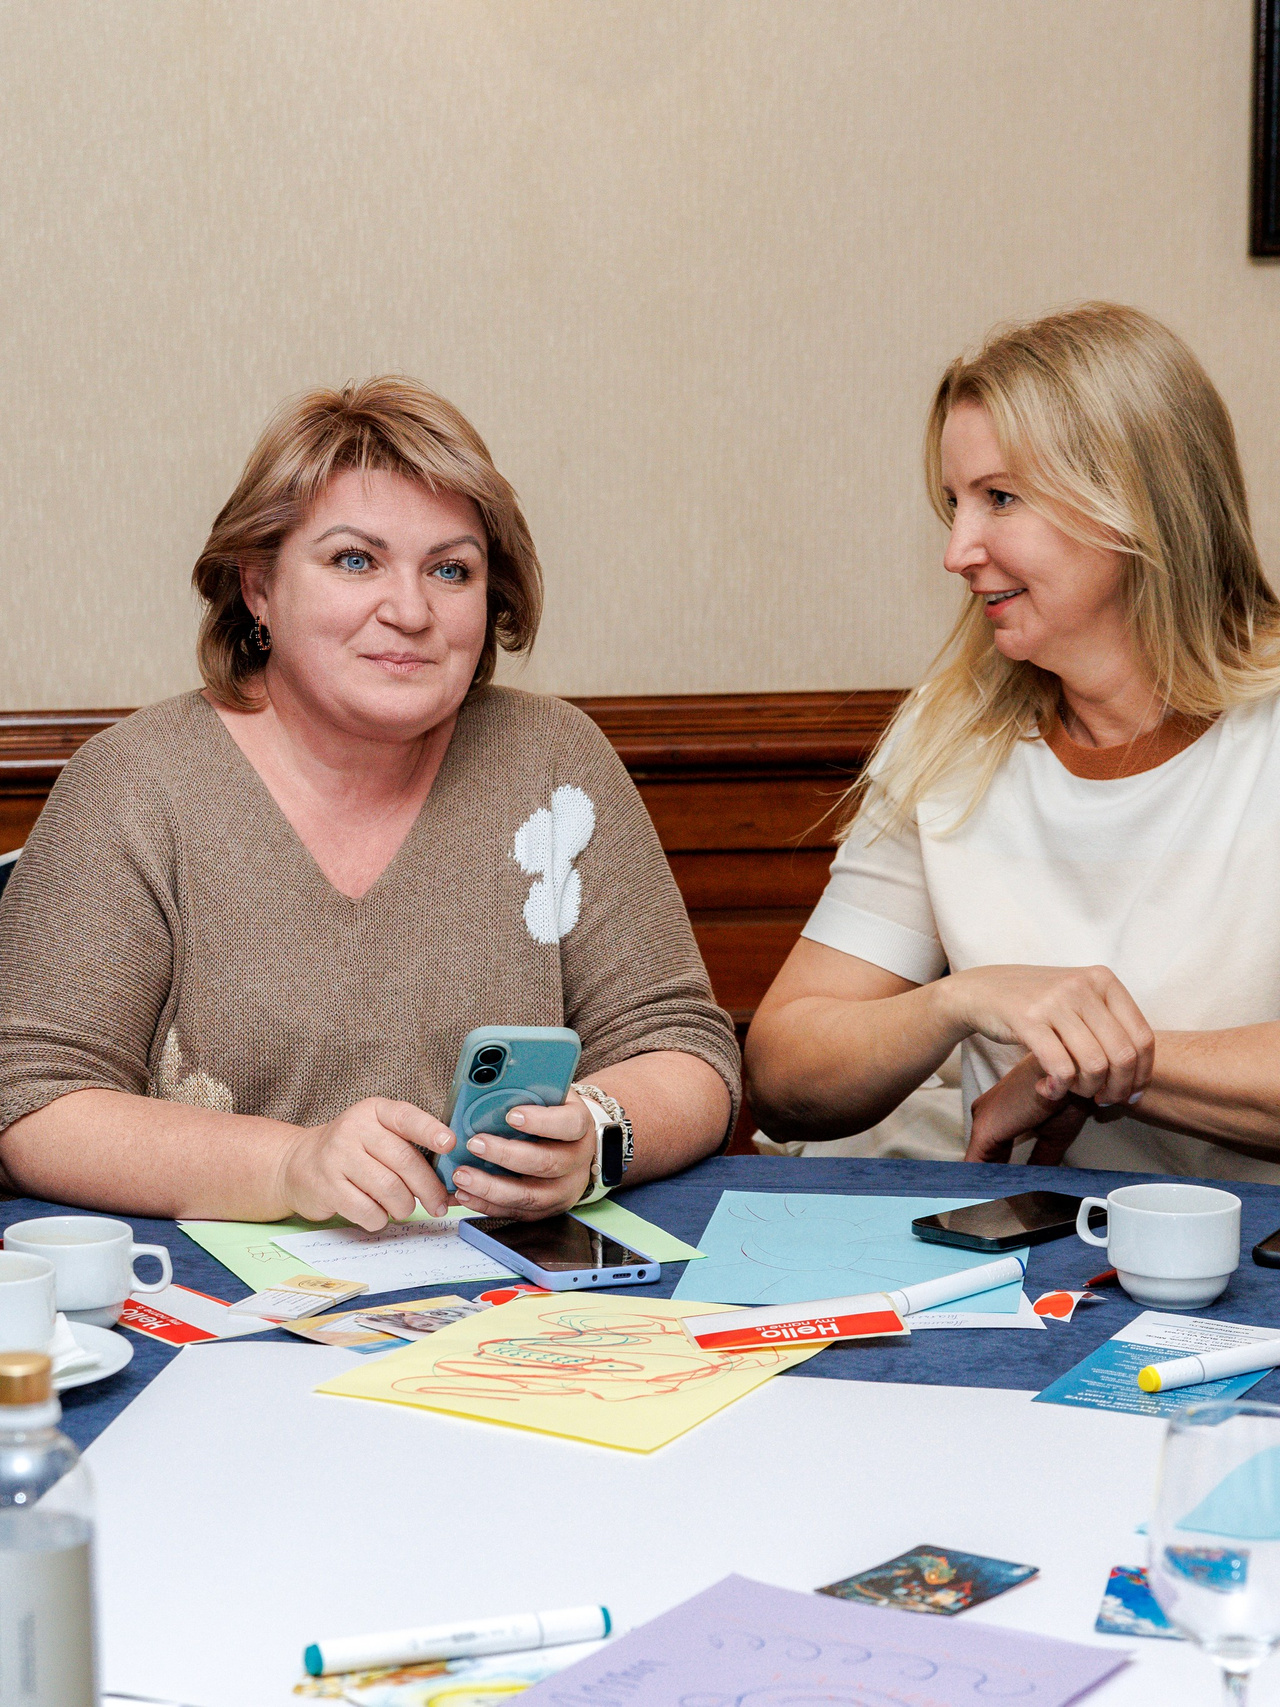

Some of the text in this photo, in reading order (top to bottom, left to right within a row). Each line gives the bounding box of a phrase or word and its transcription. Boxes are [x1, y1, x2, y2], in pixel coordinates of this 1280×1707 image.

[122, 1308, 170, 1330] Hello
[769, 1320, 810, 1329] name
[814, 1317, 836, 1325] my
[759, 1322, 840, 1339] Hello
